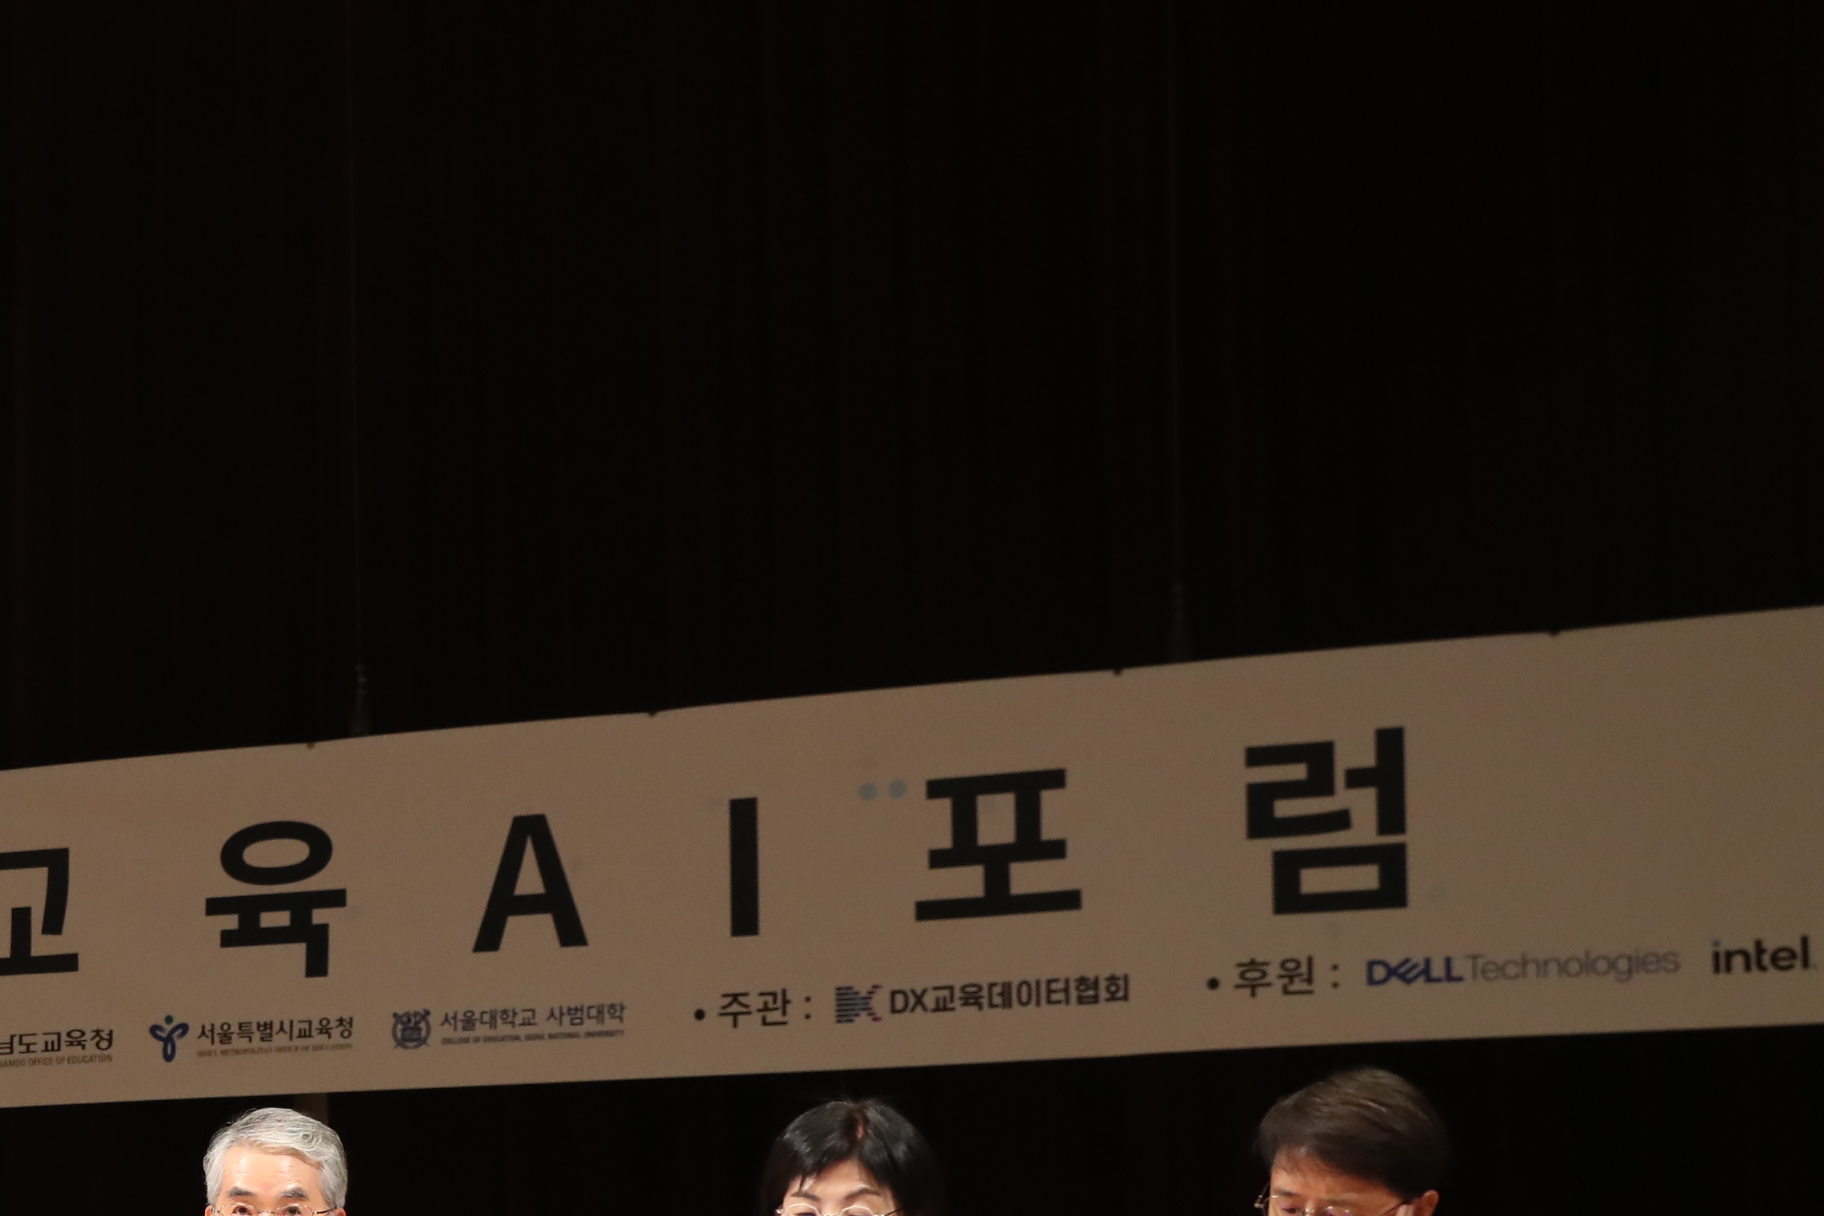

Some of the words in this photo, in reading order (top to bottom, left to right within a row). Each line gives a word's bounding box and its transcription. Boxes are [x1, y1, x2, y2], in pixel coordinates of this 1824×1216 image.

[889, 973, 1130, 1015] DX교육데이터협회
[1233, 954, 1315, 999] 후원
[439, 1007, 538, 1033] 서울대학교
[546, 1002, 627, 1027] 사범대학
[717, 987, 792, 1029] 주관
[197, 1016, 354, 1046] 서울특별시교육청
